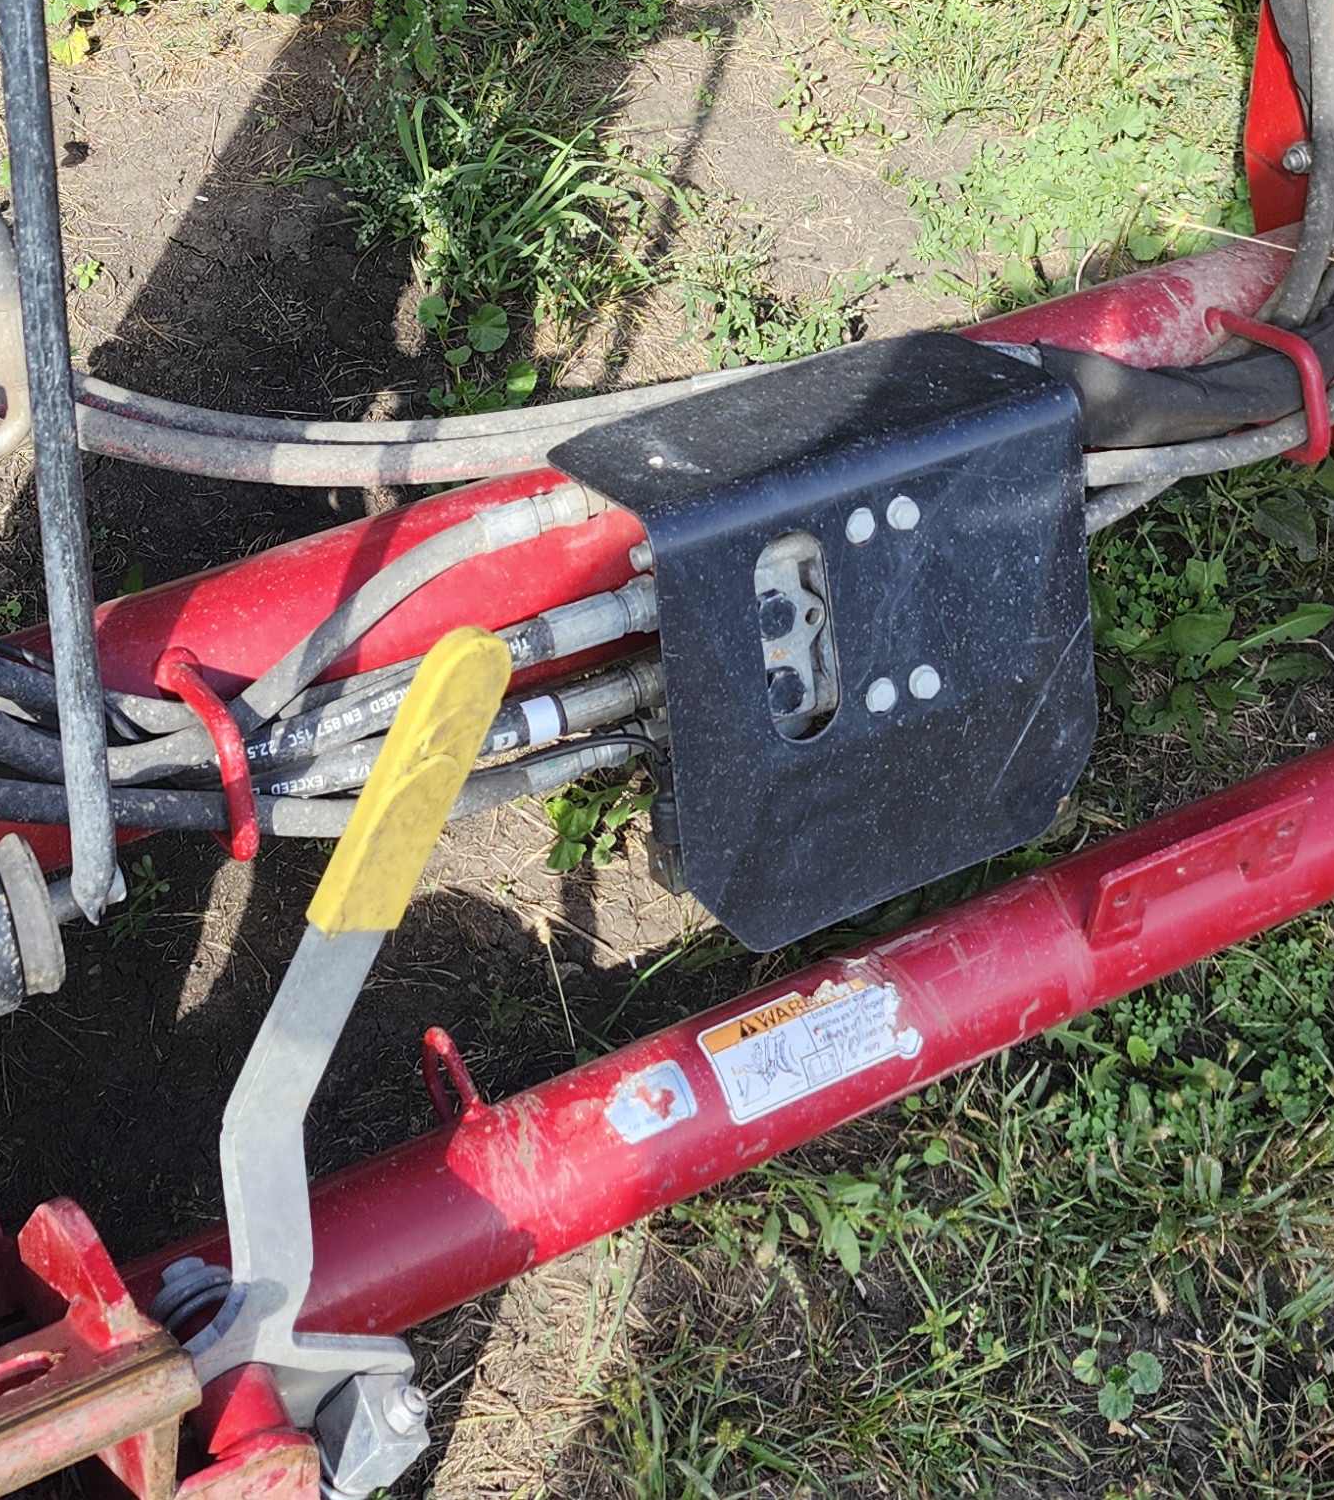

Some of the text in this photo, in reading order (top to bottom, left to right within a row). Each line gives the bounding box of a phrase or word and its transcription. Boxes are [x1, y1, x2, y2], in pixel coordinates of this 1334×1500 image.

[506, 637, 531, 655] TH
[317, 716, 343, 738] 857
[341, 707, 363, 727] EN
[270, 774, 324, 796] EXCEED
